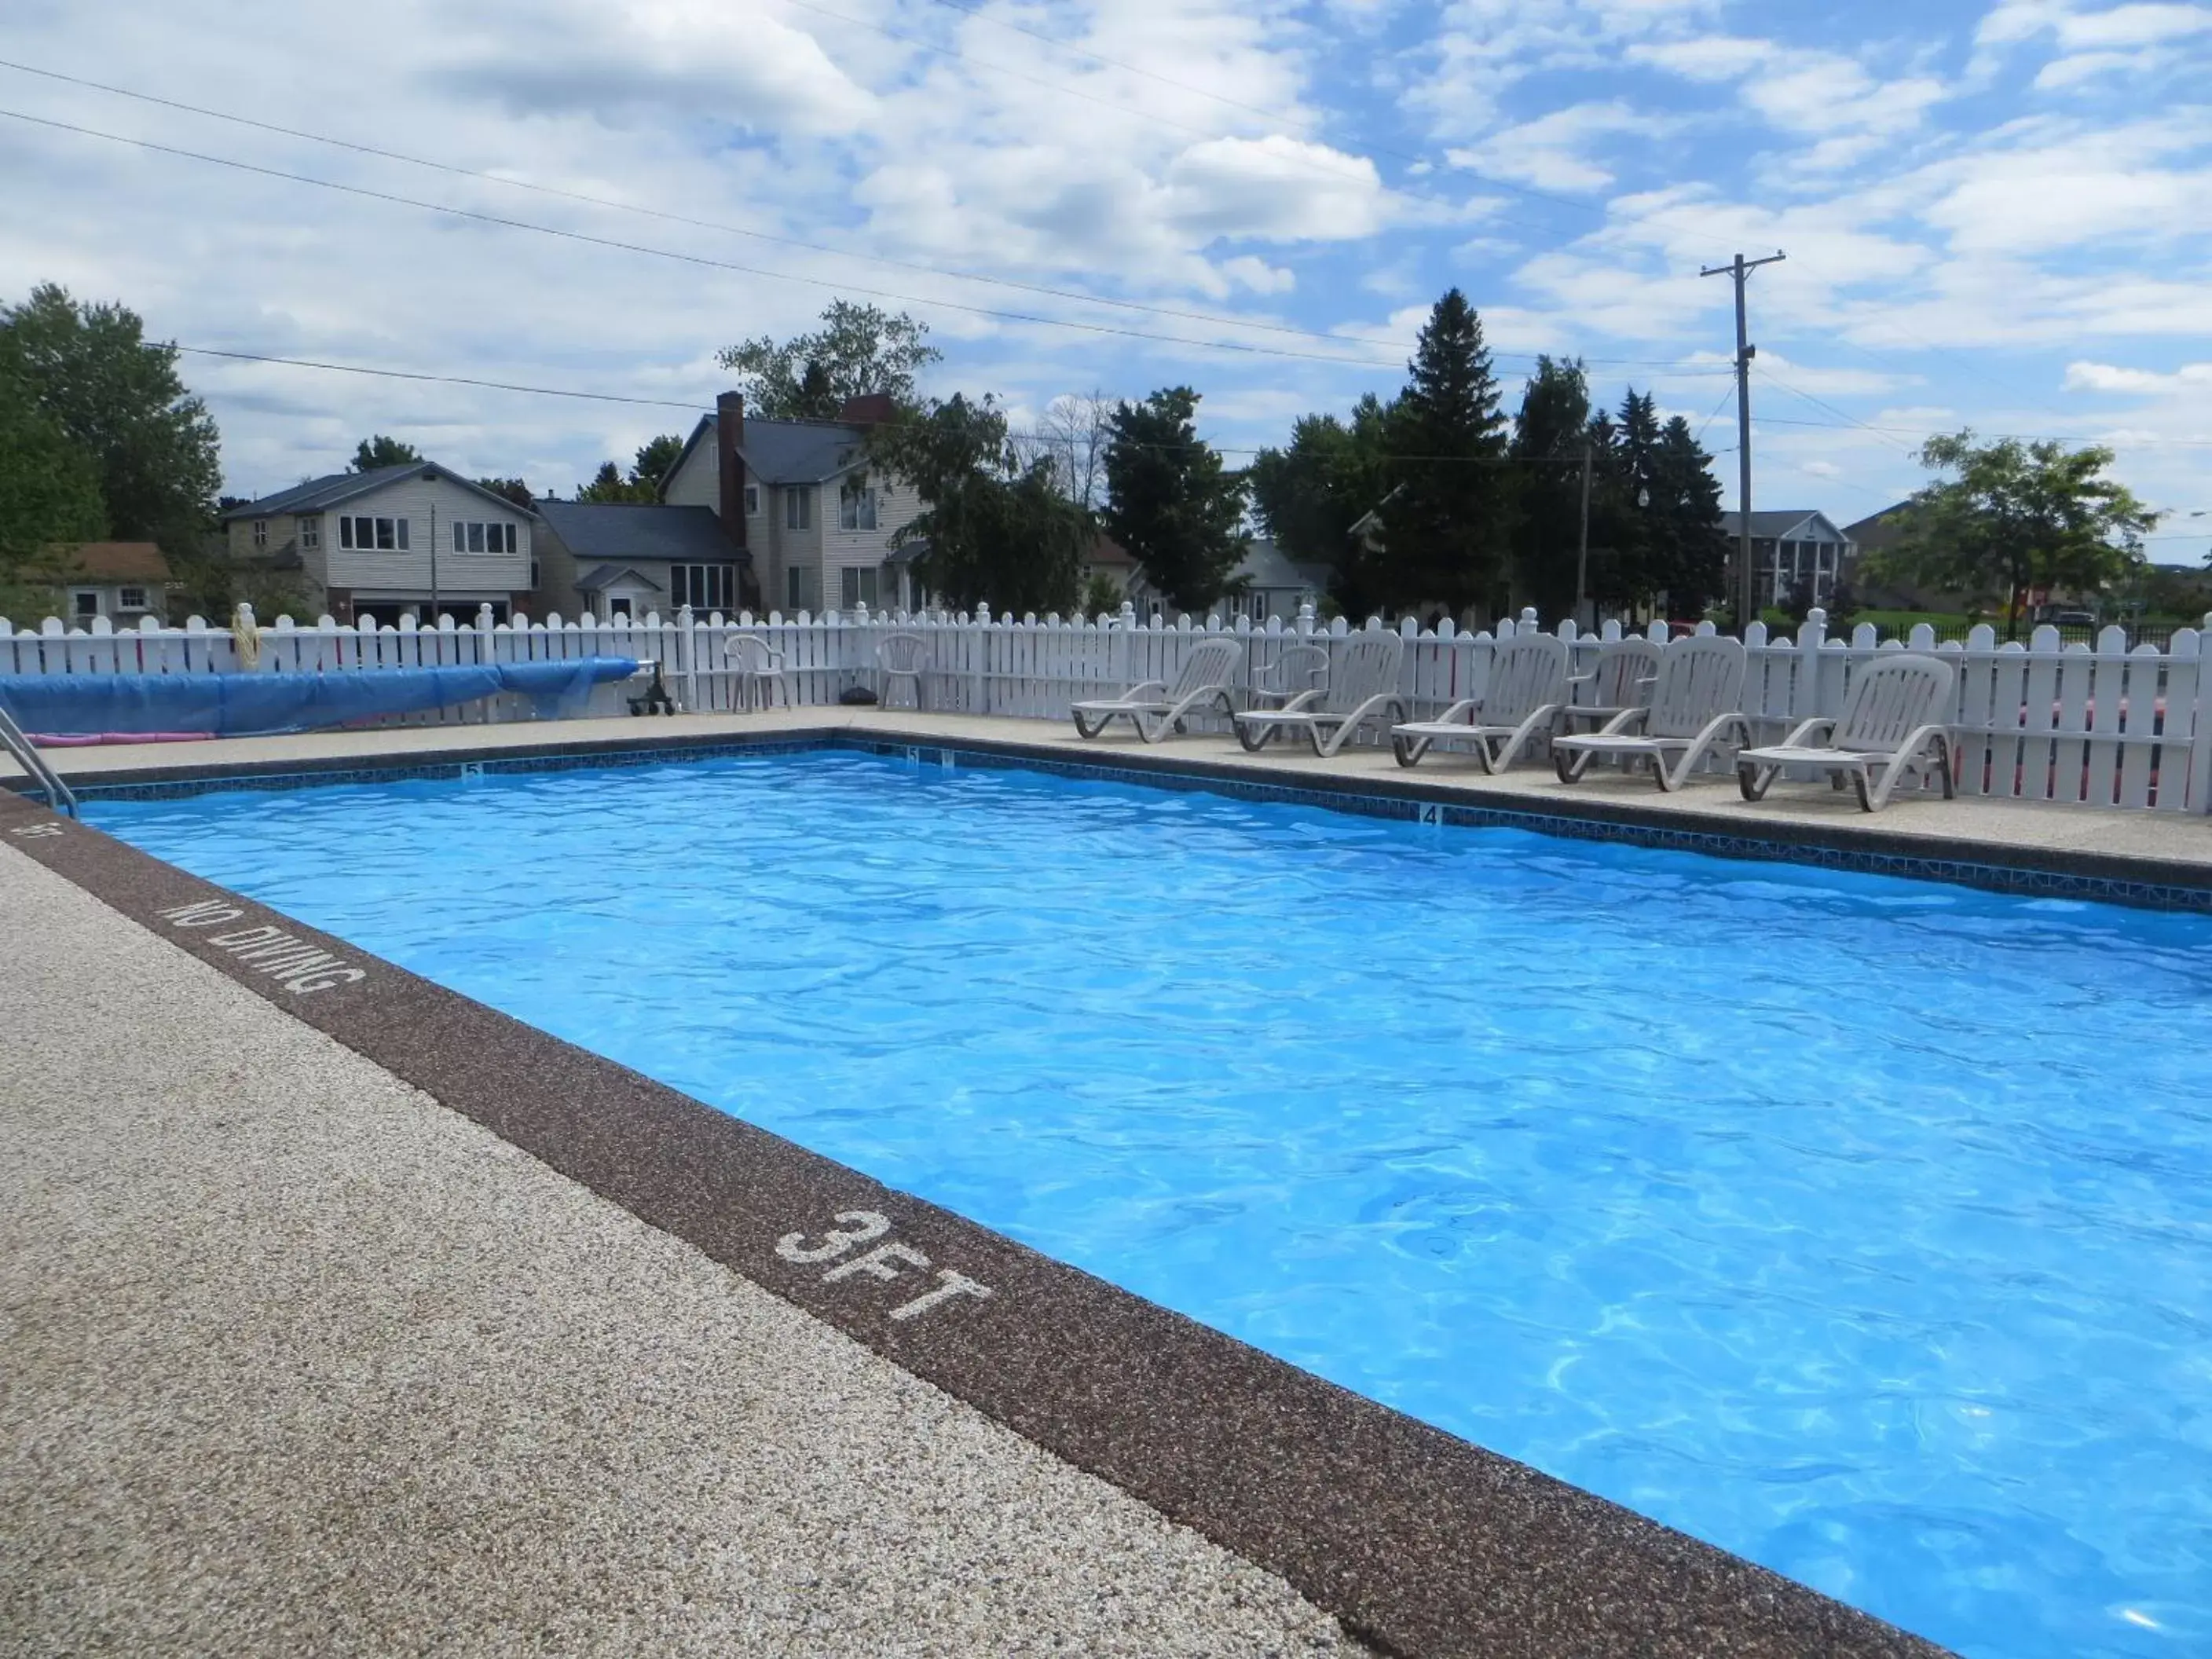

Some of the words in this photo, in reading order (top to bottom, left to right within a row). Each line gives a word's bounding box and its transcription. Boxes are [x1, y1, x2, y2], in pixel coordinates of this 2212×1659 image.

[1423, 804, 1437, 826] 4
[153, 899, 244, 927] NO
[207, 925, 367, 995] DIVING
[775, 1210, 992, 1320] 3FT
